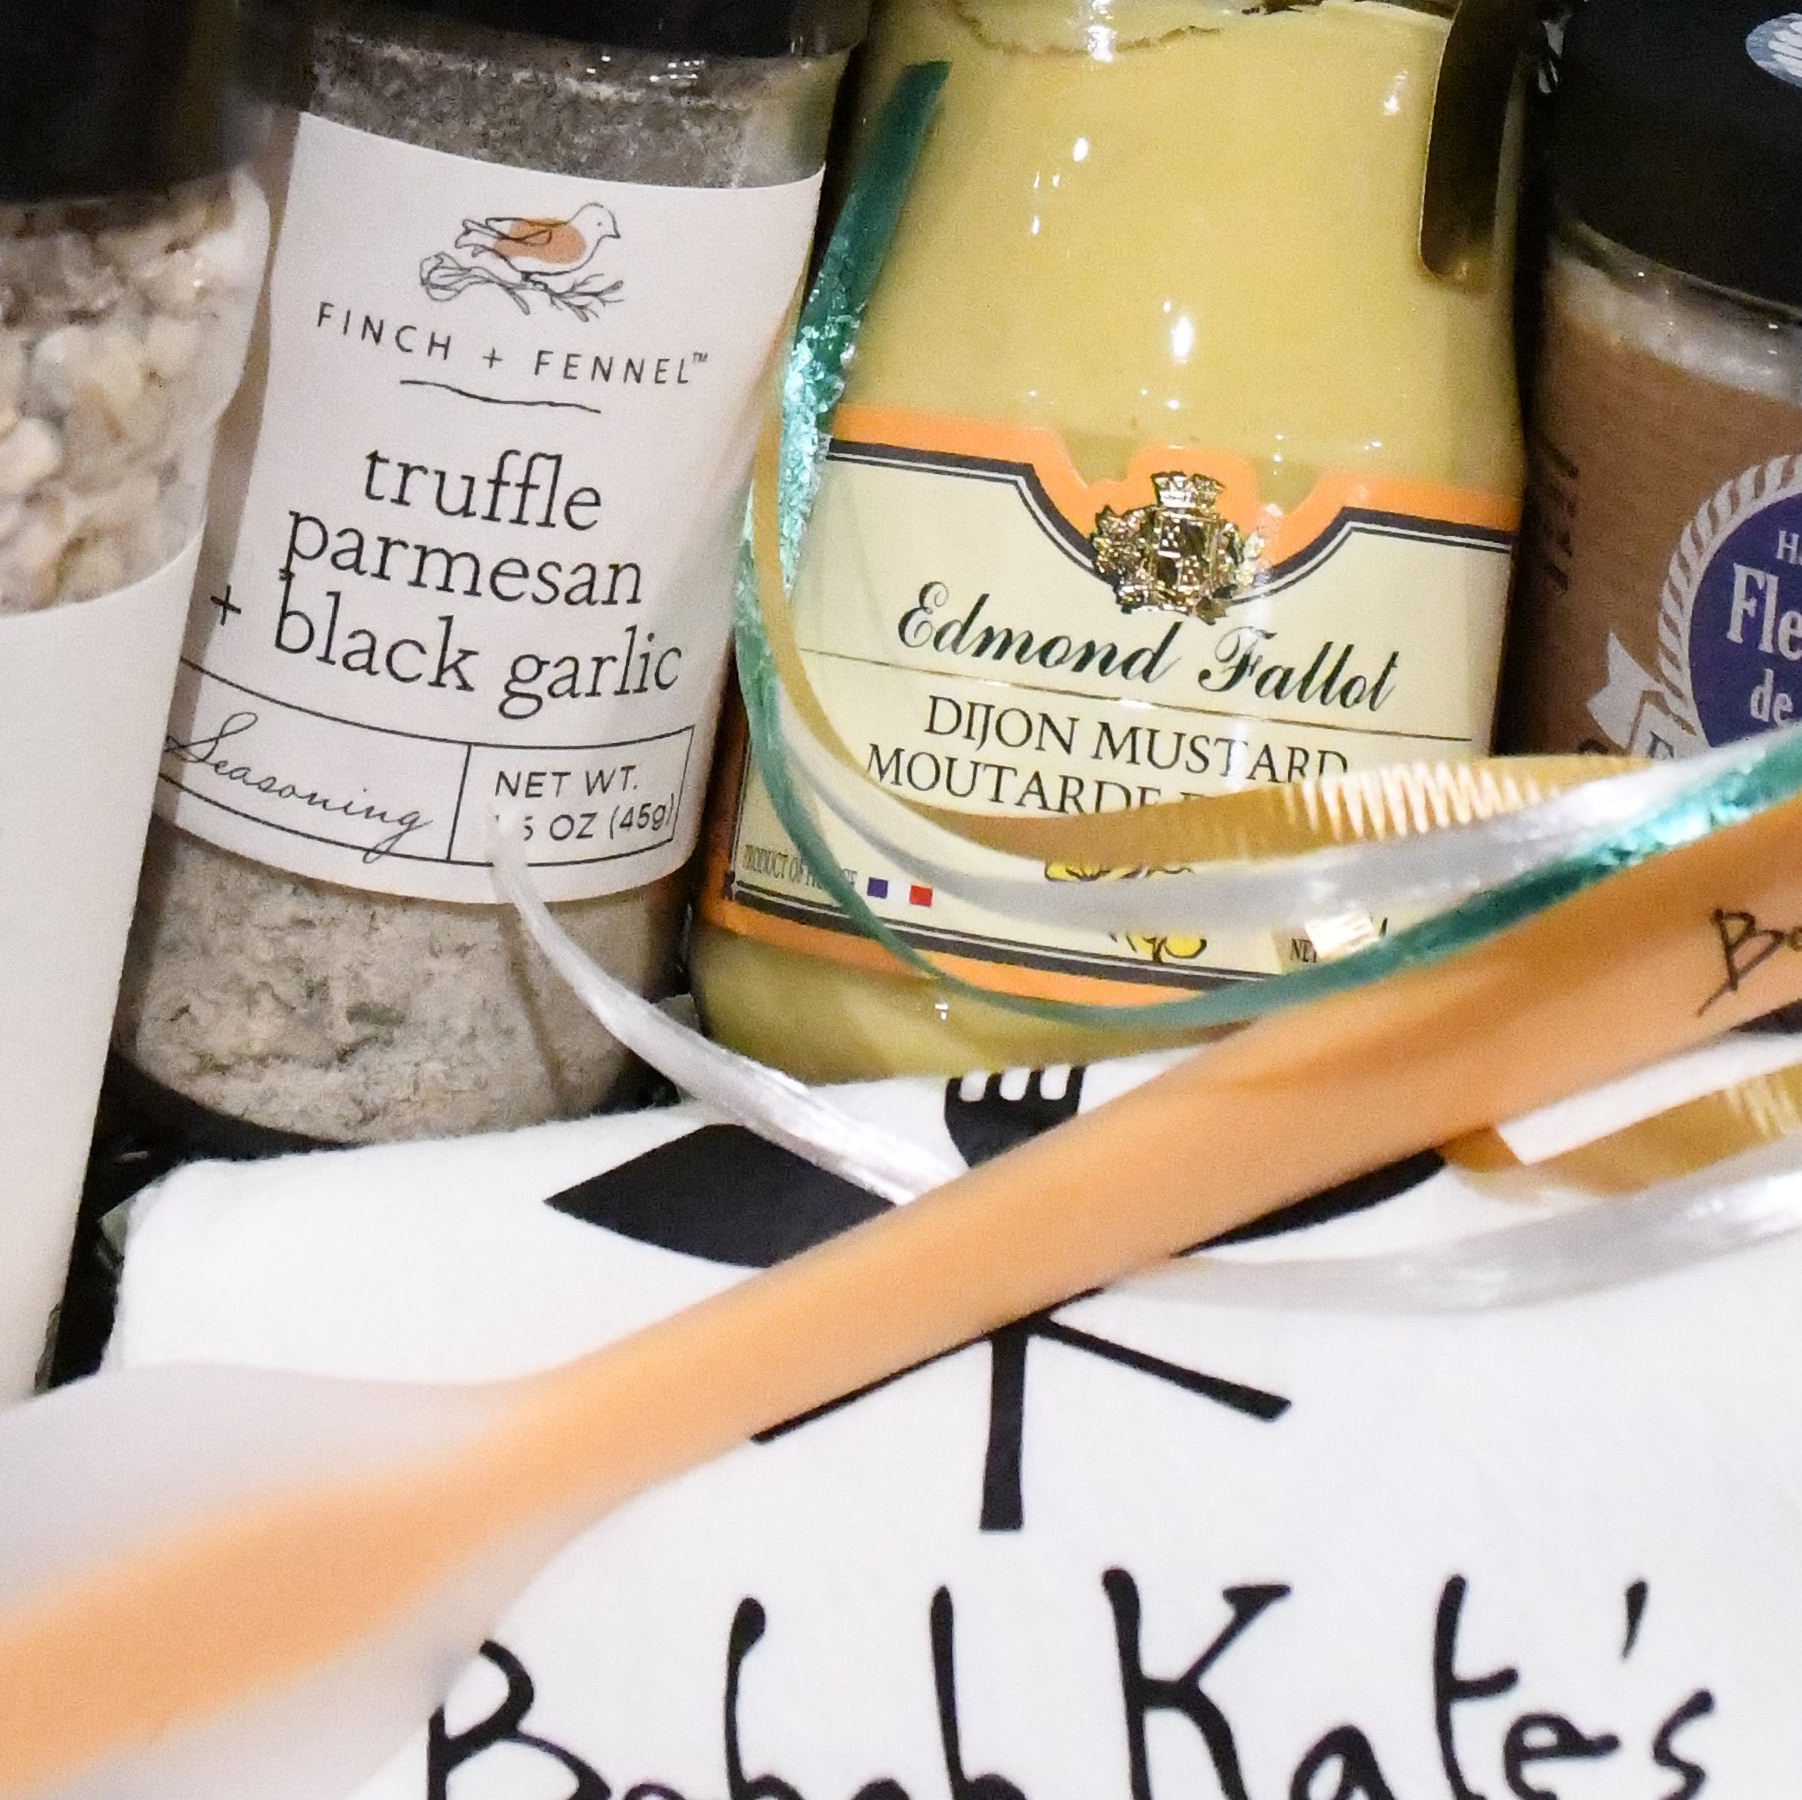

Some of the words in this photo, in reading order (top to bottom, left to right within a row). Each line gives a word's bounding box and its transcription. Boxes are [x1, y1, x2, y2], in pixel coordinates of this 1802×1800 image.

[316, 301, 453, 362] FINCH
[482, 348, 504, 370] +
[363, 448, 603, 532] truffle
[279, 510, 644, 610] parmesan
[208, 583, 243, 627] +
[272, 573, 481, 693] black
[498, 625, 684, 721] garlic
[898, 580, 1181, 685] Edmond
[1198, 624, 1401, 713] Fallot
[924, 694, 1081, 758] DIJON
[1090, 720, 1350, 786] MUSTARD
[1750, 667, 1794, 728] de
[164, 710, 434, 865] Seasoning
[494, 769, 572, 799] NET
[585, 764, 638, 797] WT.
[548, 811, 598, 841] OZ
[608, 792, 676, 840] (45g)
